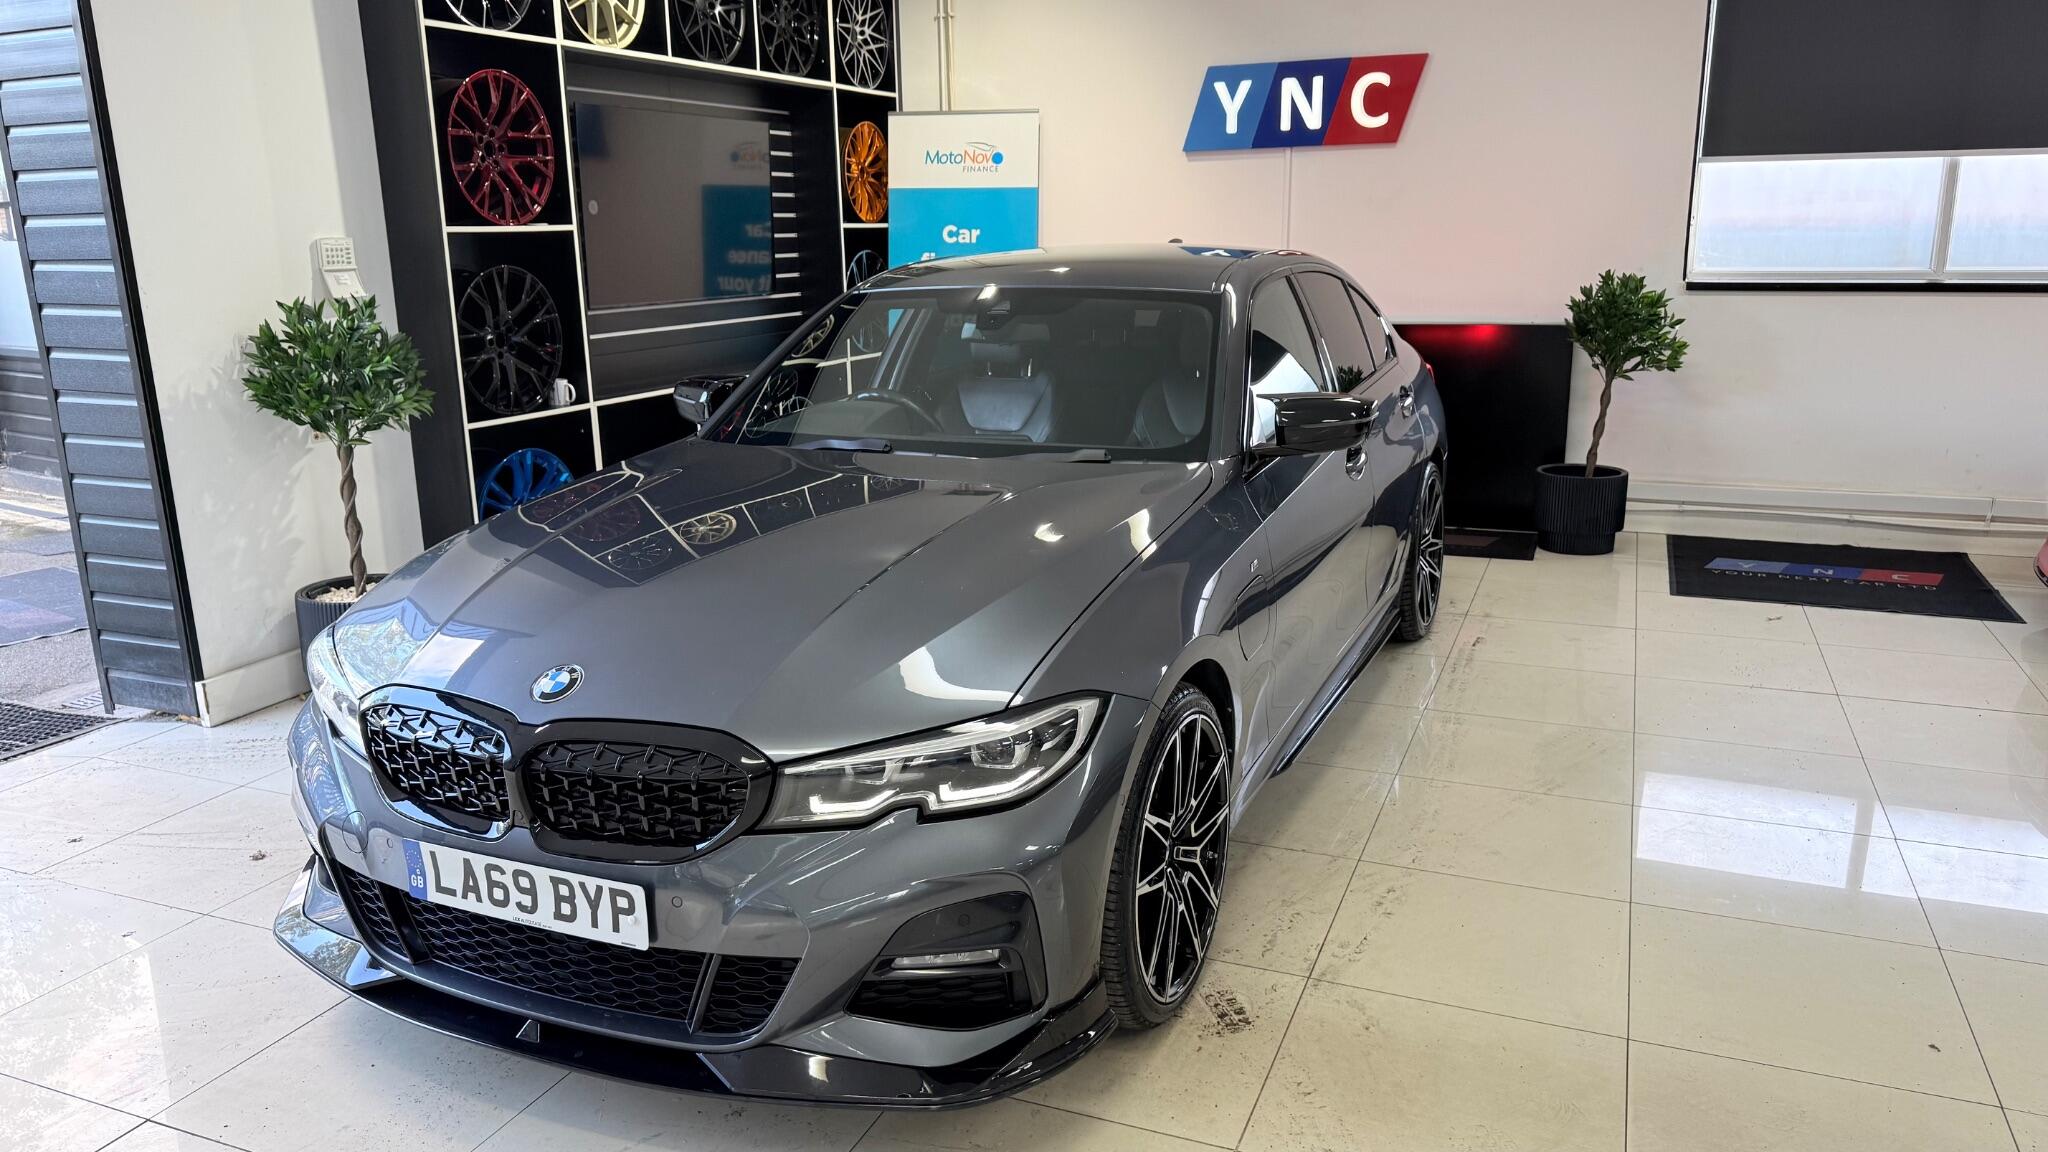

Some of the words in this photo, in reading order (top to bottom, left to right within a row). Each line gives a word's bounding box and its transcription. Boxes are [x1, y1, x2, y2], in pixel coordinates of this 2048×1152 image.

[924, 147, 1004, 165] MotoNovo
[962, 165, 999, 173] FINANCE
[942, 224, 981, 244] Car
[410, 874, 424, 889] GB
[429, 850, 539, 915] LA69
[549, 875, 636, 934] BYP
